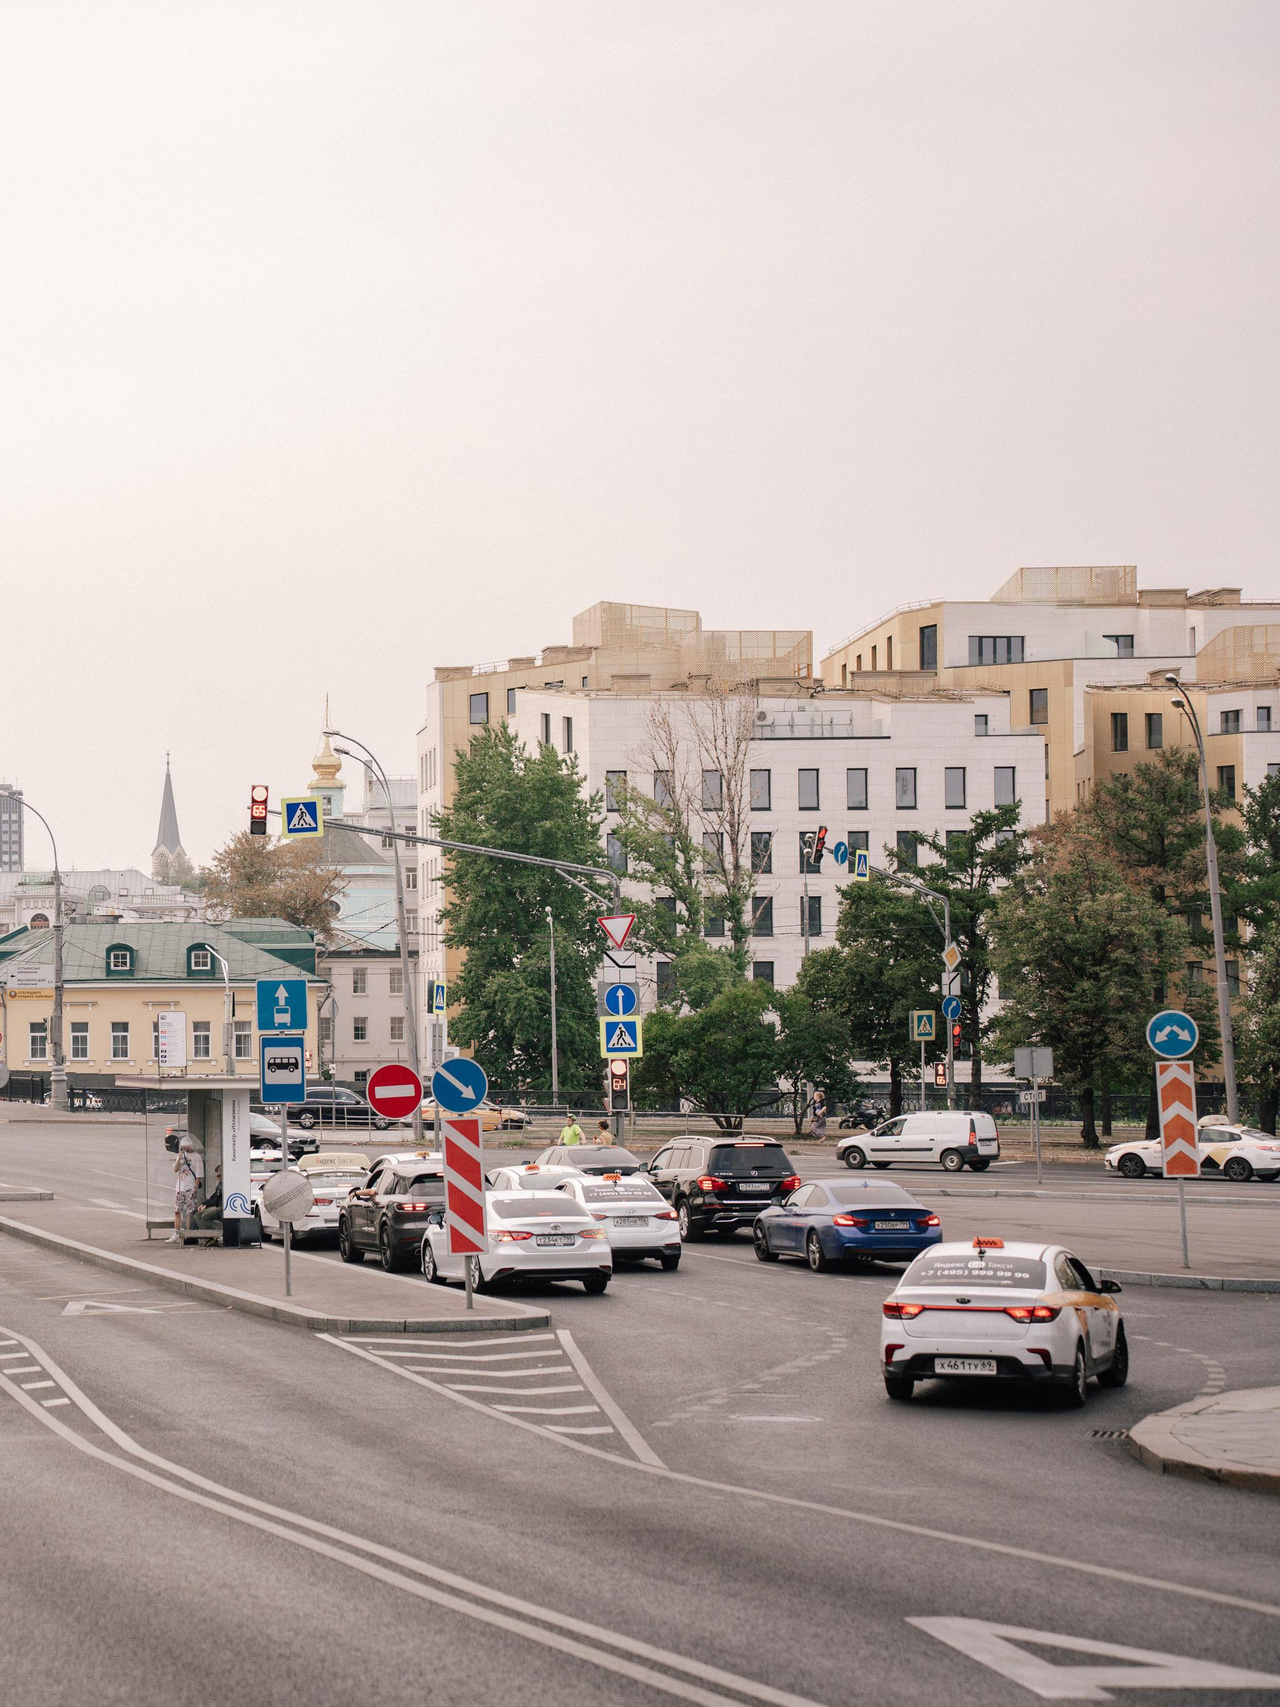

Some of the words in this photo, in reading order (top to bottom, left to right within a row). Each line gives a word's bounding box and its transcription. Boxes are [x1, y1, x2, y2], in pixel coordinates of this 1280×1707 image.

[253, 805, 266, 817] 65
[612, 1078, 627, 1090] 64
[315, 1157, 336, 1166] Яндекс
[337, 1156, 354, 1165] Такси
